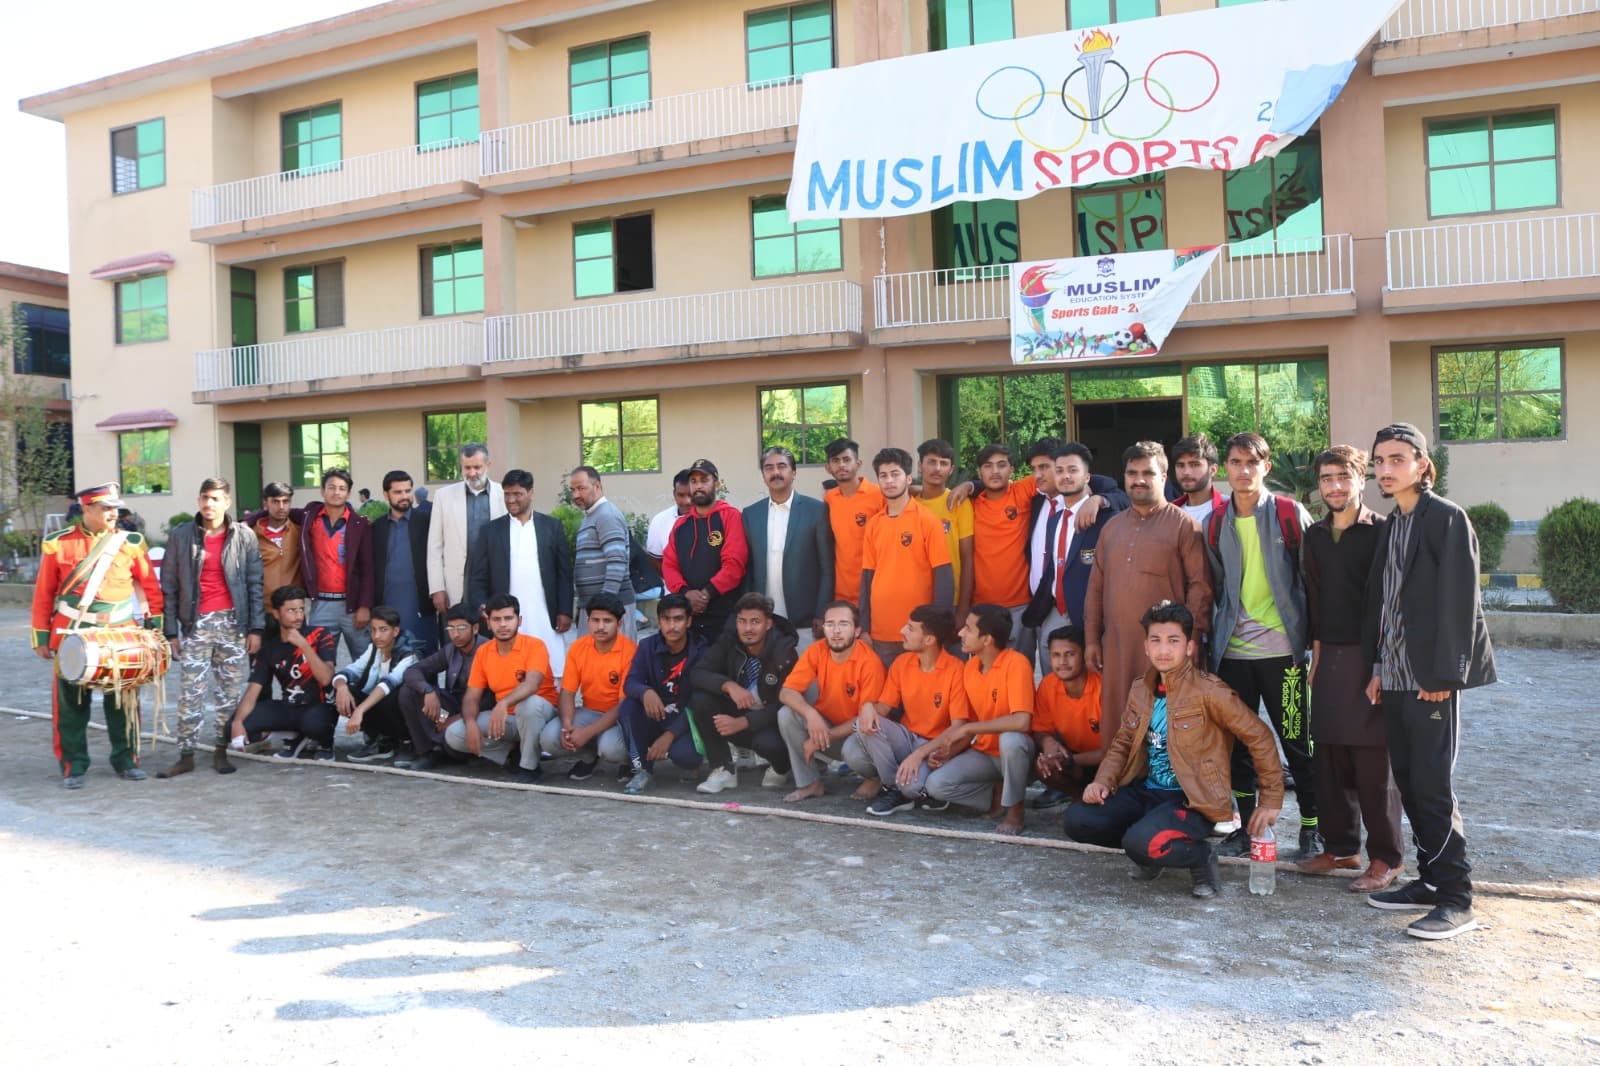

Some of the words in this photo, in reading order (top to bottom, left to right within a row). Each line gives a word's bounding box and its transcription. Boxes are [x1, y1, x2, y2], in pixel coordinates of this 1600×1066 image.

[1257, 101, 1273, 122] 2
[808, 140, 1023, 211] MUSLIM
[1033, 136, 1238, 190] SPORTS
[1067, 278, 1160, 297] MUSLIM
[1070, 294, 1118, 304] EDUCATION
[1051, 307, 1090, 319] Sports
[1092, 304, 1119, 316] Gala
[290, 664, 302, 679] 6
